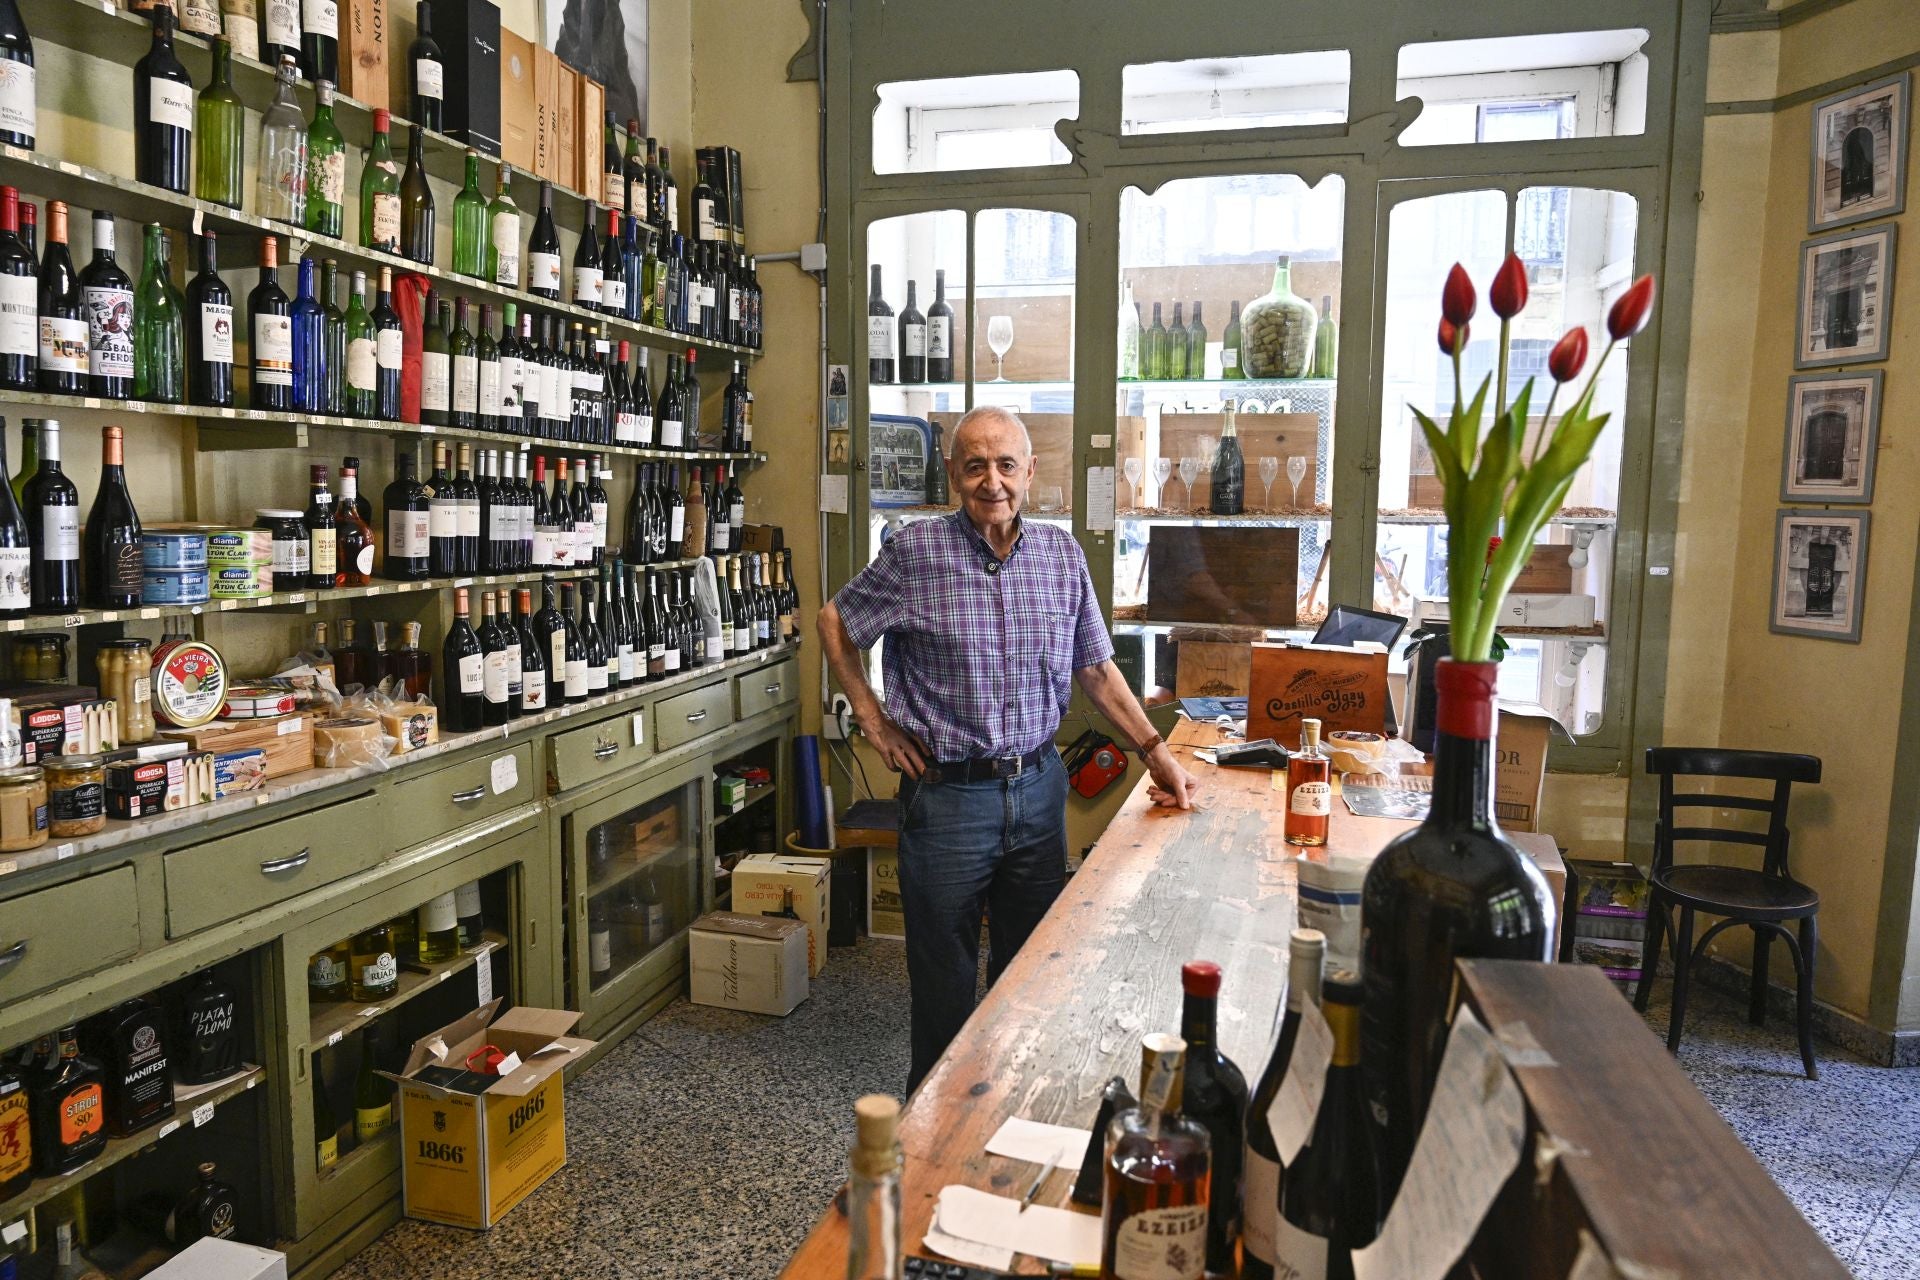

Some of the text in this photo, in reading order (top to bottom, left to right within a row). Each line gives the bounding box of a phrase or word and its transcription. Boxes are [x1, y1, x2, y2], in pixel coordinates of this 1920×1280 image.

[537, 104, 545, 169] CIRSION
[213, 537, 241, 545] diamir
[227, 549, 251, 557] CLARO
[182, 576, 202, 584] diamir
[223, 571, 250, 579] diamir
[213, 583, 260, 591] ATÚN CLARO
[172, 654, 209, 668] LA VIEIRA
[1320, 688, 1365, 713] Ygay
[32, 713, 62, 724] LODOSA
[35, 732, 59, 741] BLANCOS
[137, 767, 164, 779] LODOSA
[140, 786, 162, 795] BLANCOS
[723, 939, 738, 1002] Valduero
[191, 1006, 225, 1024] PLATA
[195, 1016, 232, 1037] PLOMO
[125, 1058, 167, 1085] MANIFEST
[66, 1095, 98, 1117] STROH
[508, 1090, 545, 1135] 1866
[418, 1140, 464, 1164] 1866
